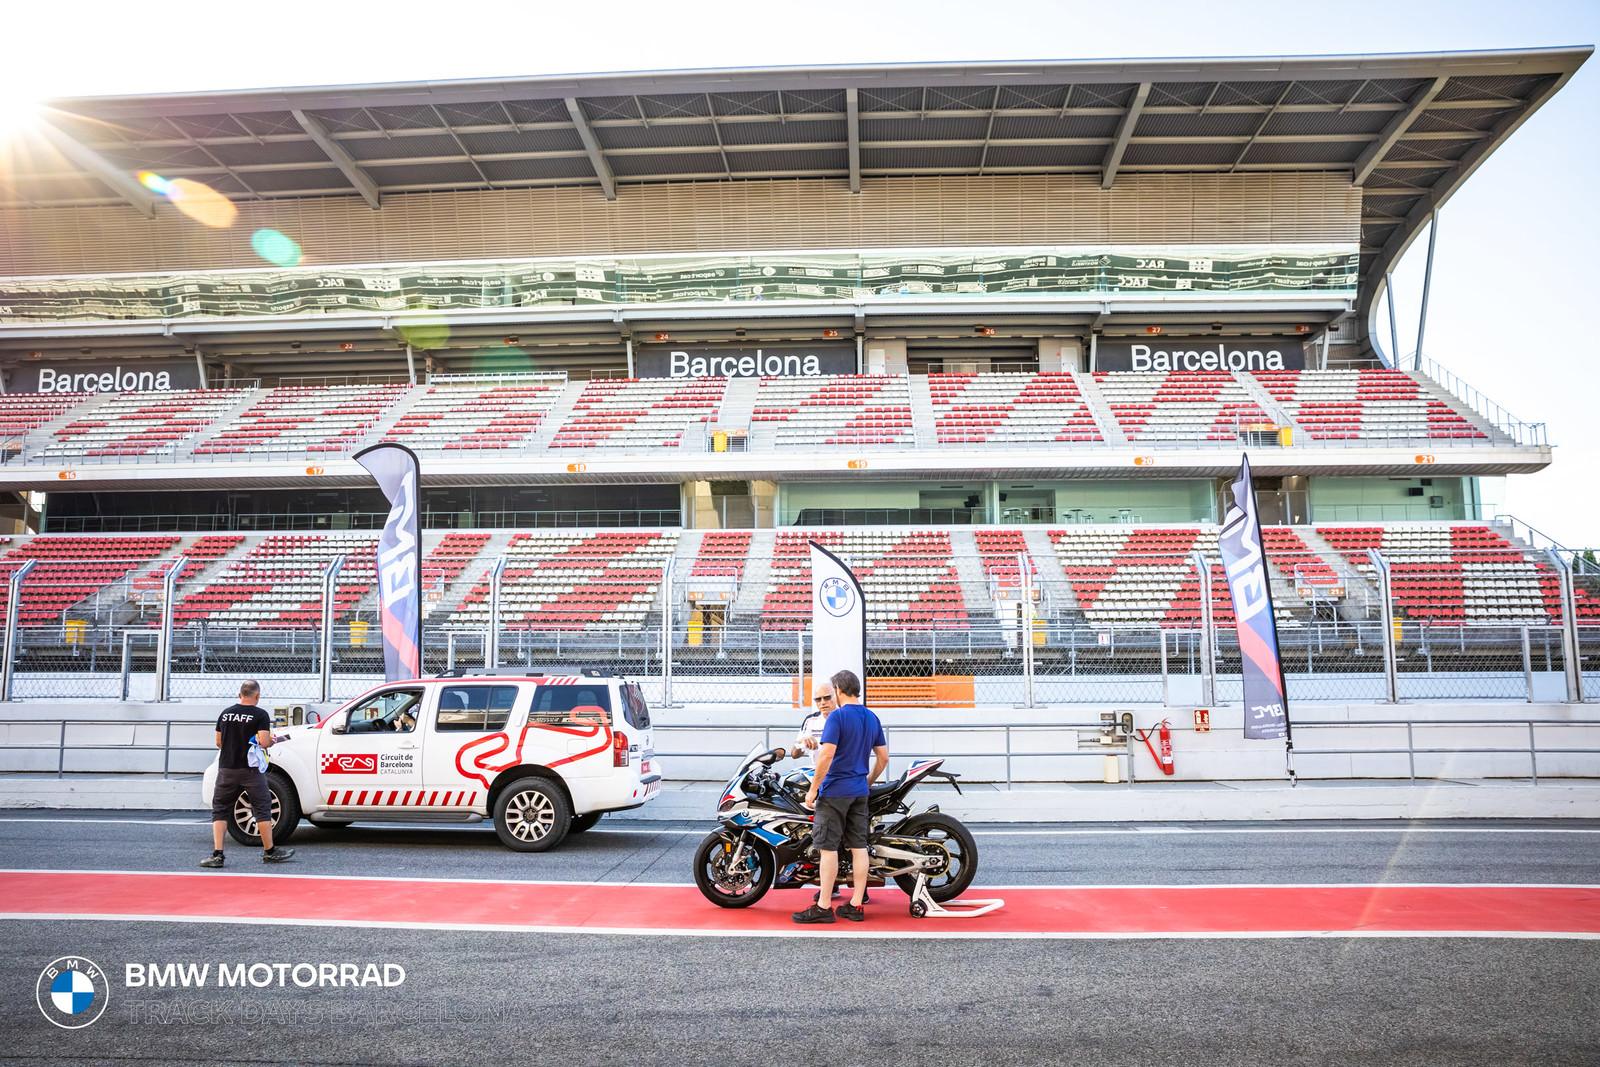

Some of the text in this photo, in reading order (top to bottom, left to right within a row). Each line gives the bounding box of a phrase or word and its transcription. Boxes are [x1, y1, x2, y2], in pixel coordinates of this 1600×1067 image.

[1131, 344, 1285, 372] Barcelona
[670, 350, 821, 378] Barcelona
[38, 367, 171, 392] Barcelona
[1141, 457, 1153, 465] 20
[1422, 455, 1433, 463] 21
[574, 464, 585, 472] 18
[855, 460, 866, 468] 19
[222, 713, 254, 723] STAFF
[380, 753, 413, 761] Circuit de
[380, 760, 413, 768] Barcelona
